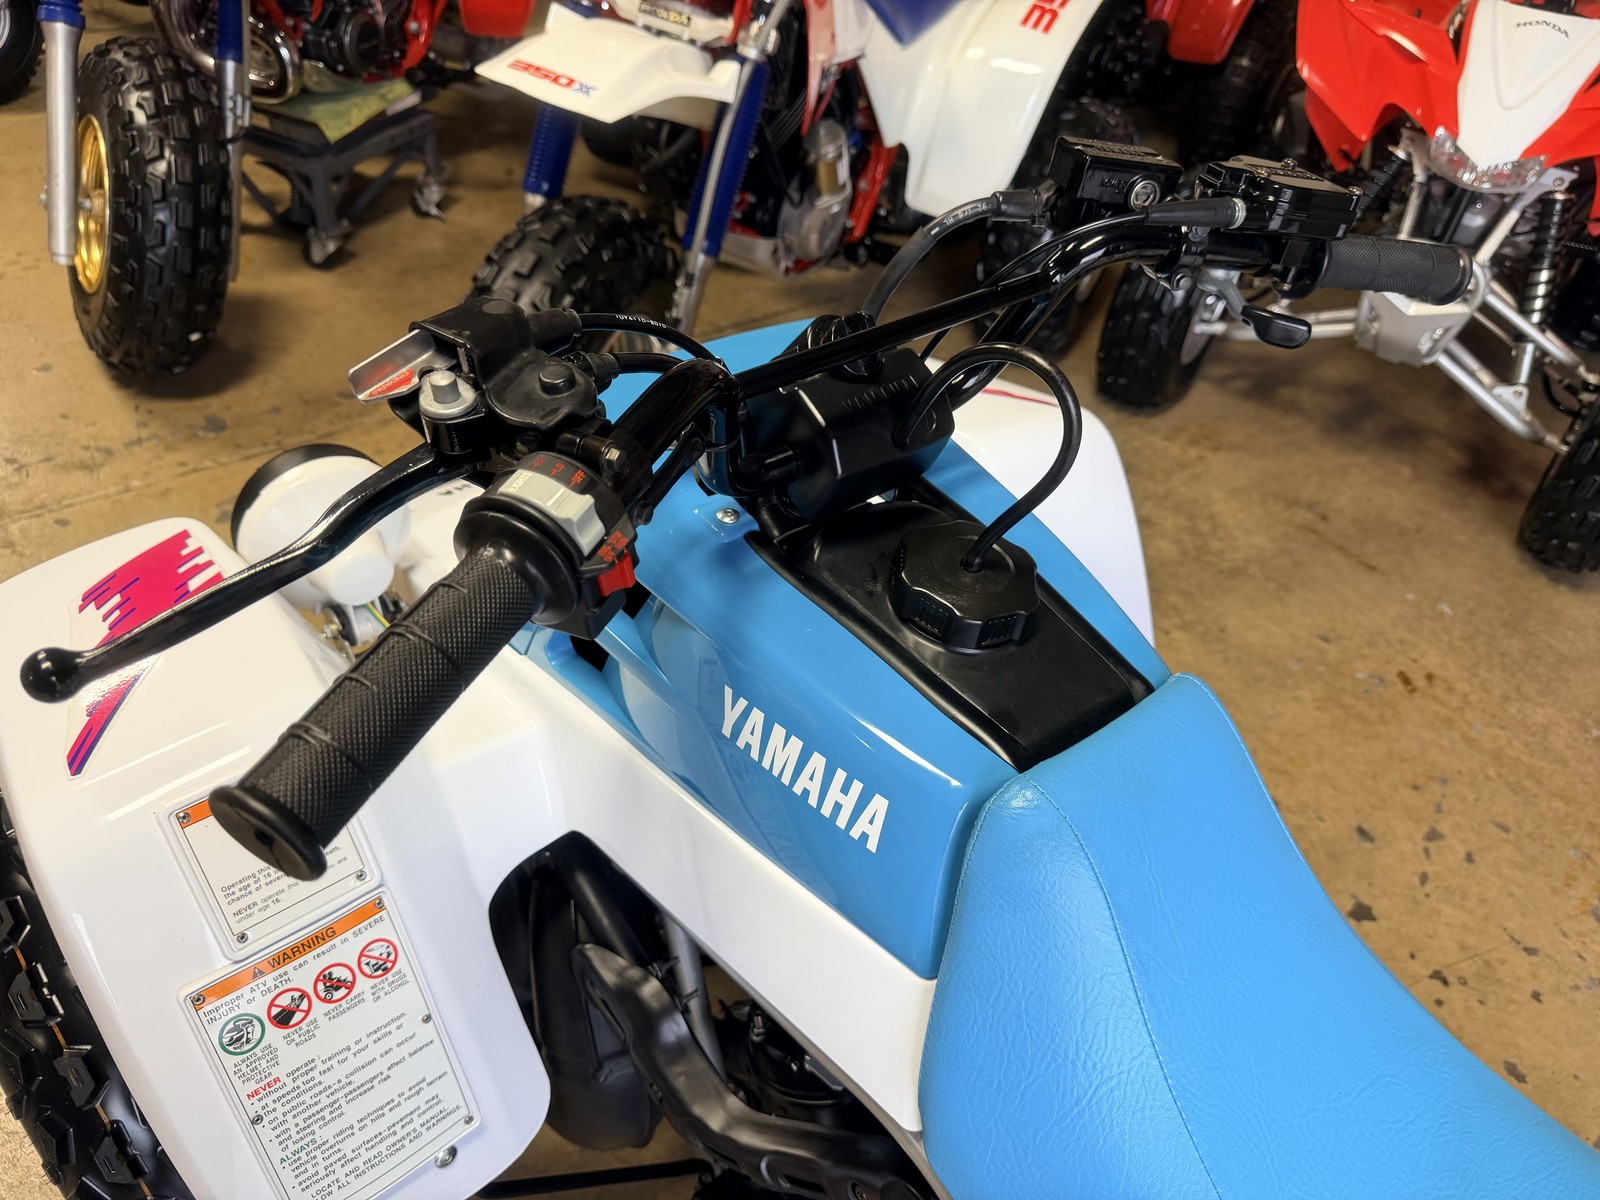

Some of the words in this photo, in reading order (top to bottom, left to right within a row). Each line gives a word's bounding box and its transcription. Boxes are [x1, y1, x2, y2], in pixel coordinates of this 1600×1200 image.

[1515, 20, 1569, 39] HONDA
[721, 684, 889, 854] YAMAHA
[221, 871, 257, 893] Operating
[257, 865, 271, 875] this
[223, 890, 236, 899] the
[238, 882, 251, 893] age
[253, 876, 261, 885] of
[262, 871, 272, 879] 16
[227, 889, 253, 906] chance
[254, 883, 263, 892] of
[232, 900, 258, 918] NEVER
[260, 887, 285, 904] operate
[235, 910, 255, 924] under
[257, 903, 270, 913] age
[267, 926, 338, 970] WARNING
[203, 993, 245, 1017] Improper
[249, 979, 267, 994] ATV
[272, 970, 289, 982] use
[292, 959, 309, 971] can
[312, 943, 337, 961] result
[339, 936, 349, 945] in
[352, 914, 385, 938] SEVERE
[370, 976, 389, 990] NEVER
[391, 967, 403, 978] USE
[370, 985, 386, 997] WITH
[386, 972, 407, 988] DRUGS
[372, 994, 381, 1003] OR
[384, 978, 410, 997] ALCOHOL
[206, 1002, 240, 1026] INJURY
[246, 995, 256, 1005] or
[260, 976, 294, 997] DEATH.
[323, 1002, 343, 1018] NEVER
[345, 990, 365, 1005] CARRY
[327, 996, 366, 1022] PASSENGERS
[282, 1025, 304, 1041] NEVER
[305, 1016, 319, 1028] USE
[285, 1036, 296, 1046] ON
[297, 1023, 320, 1039] PUBLIC
[294, 1032, 316, 1048] ROADS
[233, 1051, 257, 1069] ALWAYS
[259, 1042, 273, 1053] USE
[233, 1067, 243, 1076] AN
[245, 1046, 279, 1069] APPROVED
[237, 1062, 262, 1081] HELMET
[265, 1053, 279, 1065] AND
[256, 1081, 287, 1103] without
[291, 1063, 317, 1084] proper
[320, 1044, 351, 1065] training
[354, 1037, 362, 1046] or
[365, 1012, 407, 1039] instruction.
[260, 1102, 269, 1111] at
[271, 1084, 301, 1104] speeds
[301, 1075, 316, 1086] too
[318, 1064, 334, 1076] fast
[336, 1055, 348, 1066] for
[351, 1043, 369, 1058] your
[372, 1029, 393, 1044] skills
[395, 1022, 403, 1031] or
[241, 1059, 280, 1085] PROTECTIVE
[254, 1071, 273, 1085] GEAR
[267, 1116, 279, 1125] on
[281, 1099, 307, 1118] public
[344, 1057, 377, 1079] collision
[379, 1046, 394, 1058] can
[395, 1032, 416, 1048] occur
[246, 1076, 281, 1100] NEVER
[263, 1106, 277, 1117] the
[280, 1080, 325, 1107] conditions.
[274, 1127, 291, 1139] with
[386, 1055, 406, 1072] affect
[408, 1038, 434, 1058] balance
[270, 1117, 288, 1132] with
[291, 1098, 321, 1120] another
[325, 1079, 355, 1099] vehicle.
[277, 1133, 293, 1146] and
[295, 1114, 326, 1136] steering
[328, 1103, 343, 1116] and
[344, 1081, 375, 1105] increase
[377, 1073, 391, 1085] risk
[280, 1143, 289, 1153] of
[291, 1128, 316, 1146] losing
[318, 1110, 346, 1130] control.
[287, 1155, 302, 1167] use
[305, 1138, 329, 1158] proper
[332, 1123, 355, 1140] riding
[356, 1097, 395, 1124] techniques
[408, 1076, 427, 1092] avoid
[290, 1154, 318, 1173] vehicle
[320, 1131, 355, 1155] overturns
[358, 1122, 368, 1132] on
[370, 1109, 386, 1124] hills
[388, 1100, 402, 1113] and
[403, 1086, 424, 1102] rough
[426, 1070, 448, 1087] terrain
[297, 1169, 320, 1187] avoid
[323, 1152, 347, 1172] paved
[424, 1092, 440, 1105] may
[300, 1168, 336, 1193] seriously
[340, 1151, 362, 1169] affect
[364, 1129, 397, 1153] handling
[400, 1116, 414, 1130] and
[417, 1097, 444, 1118] control.
[293, 1166, 309, 1180] and
[310, 1161, 320, 1169] in
[321, 1147, 344, 1162] turns.
[311, 1177, 341, 1198] LOCATE
[344, 1165, 360, 1179] AND
[362, 1150, 383, 1167] READ
[385, 1127, 418, 1152] OWNER'S
[337, 1179, 352, 1191] ALL
[353, 1142, 406, 1180] INSTRUCTIONS
[408, 1130, 423, 1144] AND
